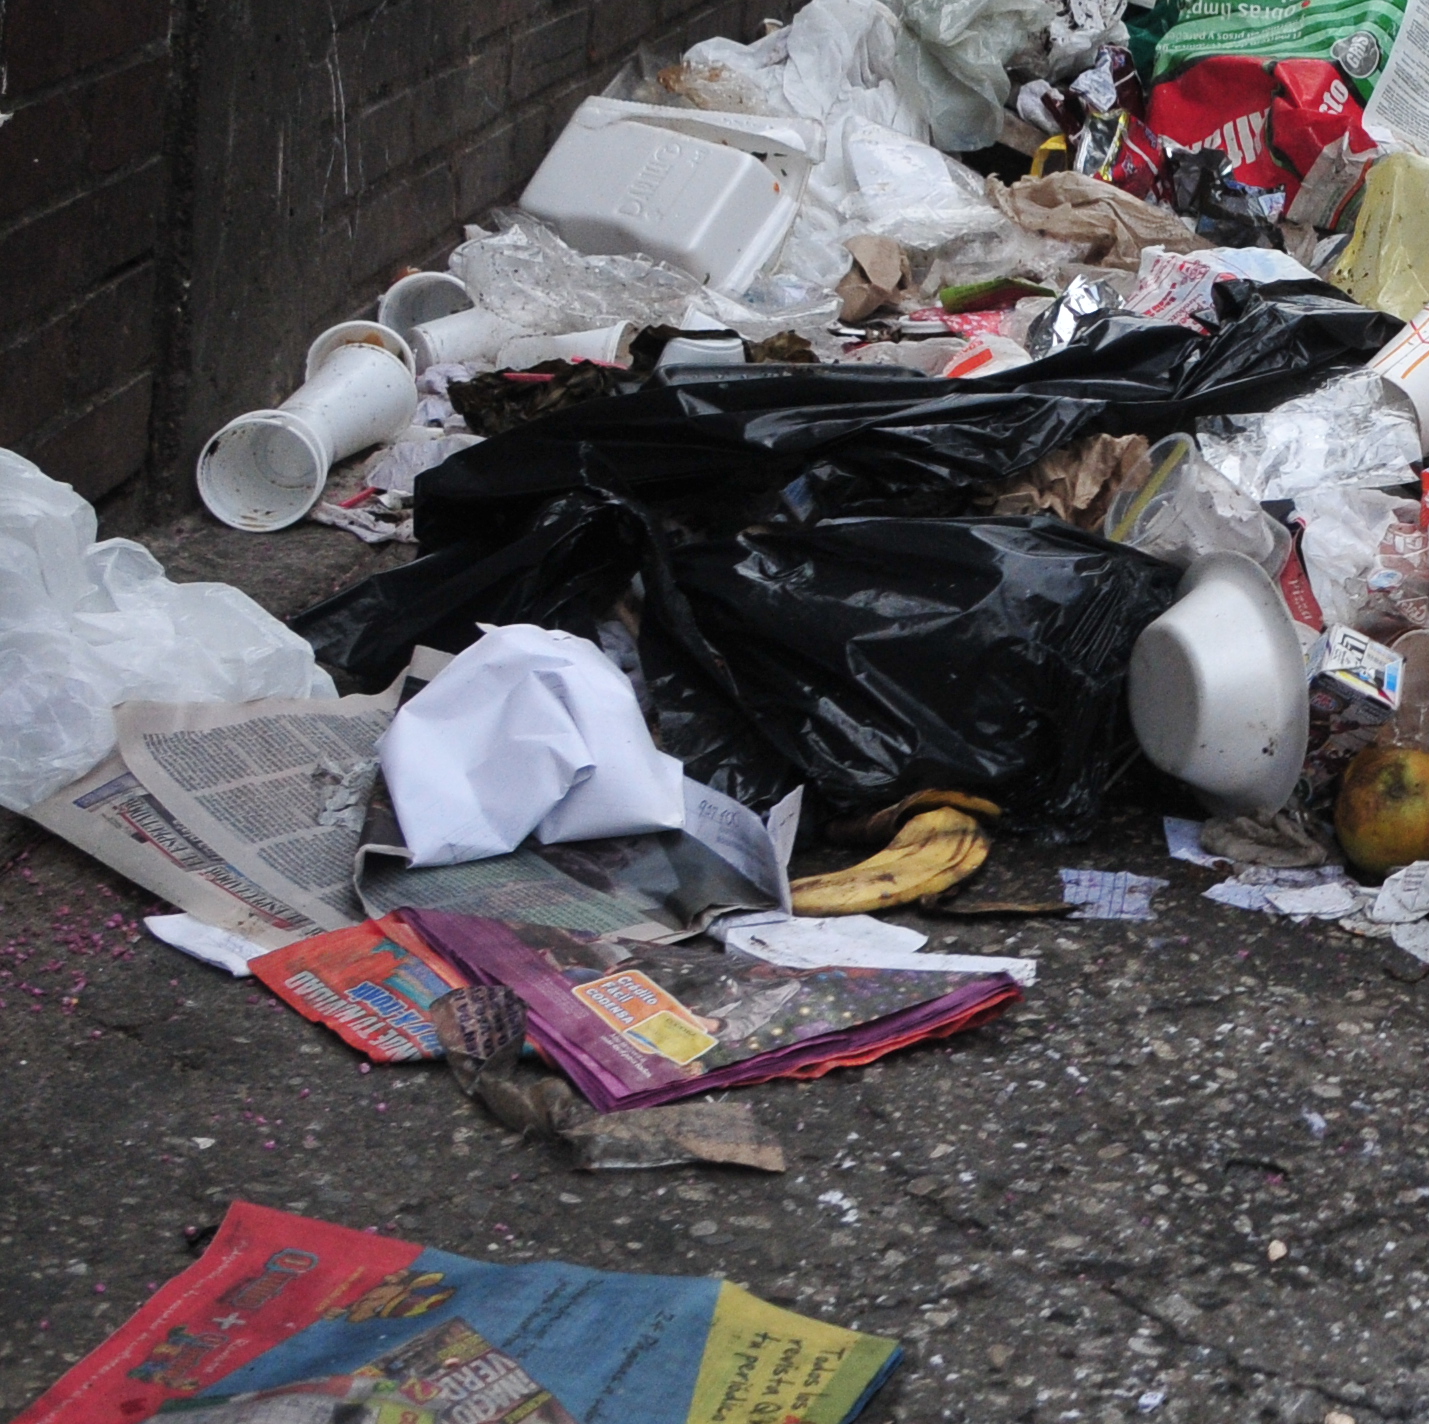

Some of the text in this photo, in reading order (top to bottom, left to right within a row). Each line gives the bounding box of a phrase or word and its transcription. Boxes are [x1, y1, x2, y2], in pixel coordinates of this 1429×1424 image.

[1238, 1, 1298, 22] obras
[284, 969, 368, 1024] NAVIDAD
[585, 987, 636, 1026] CODENSA
[617, 975, 659, 1006] Crédito
